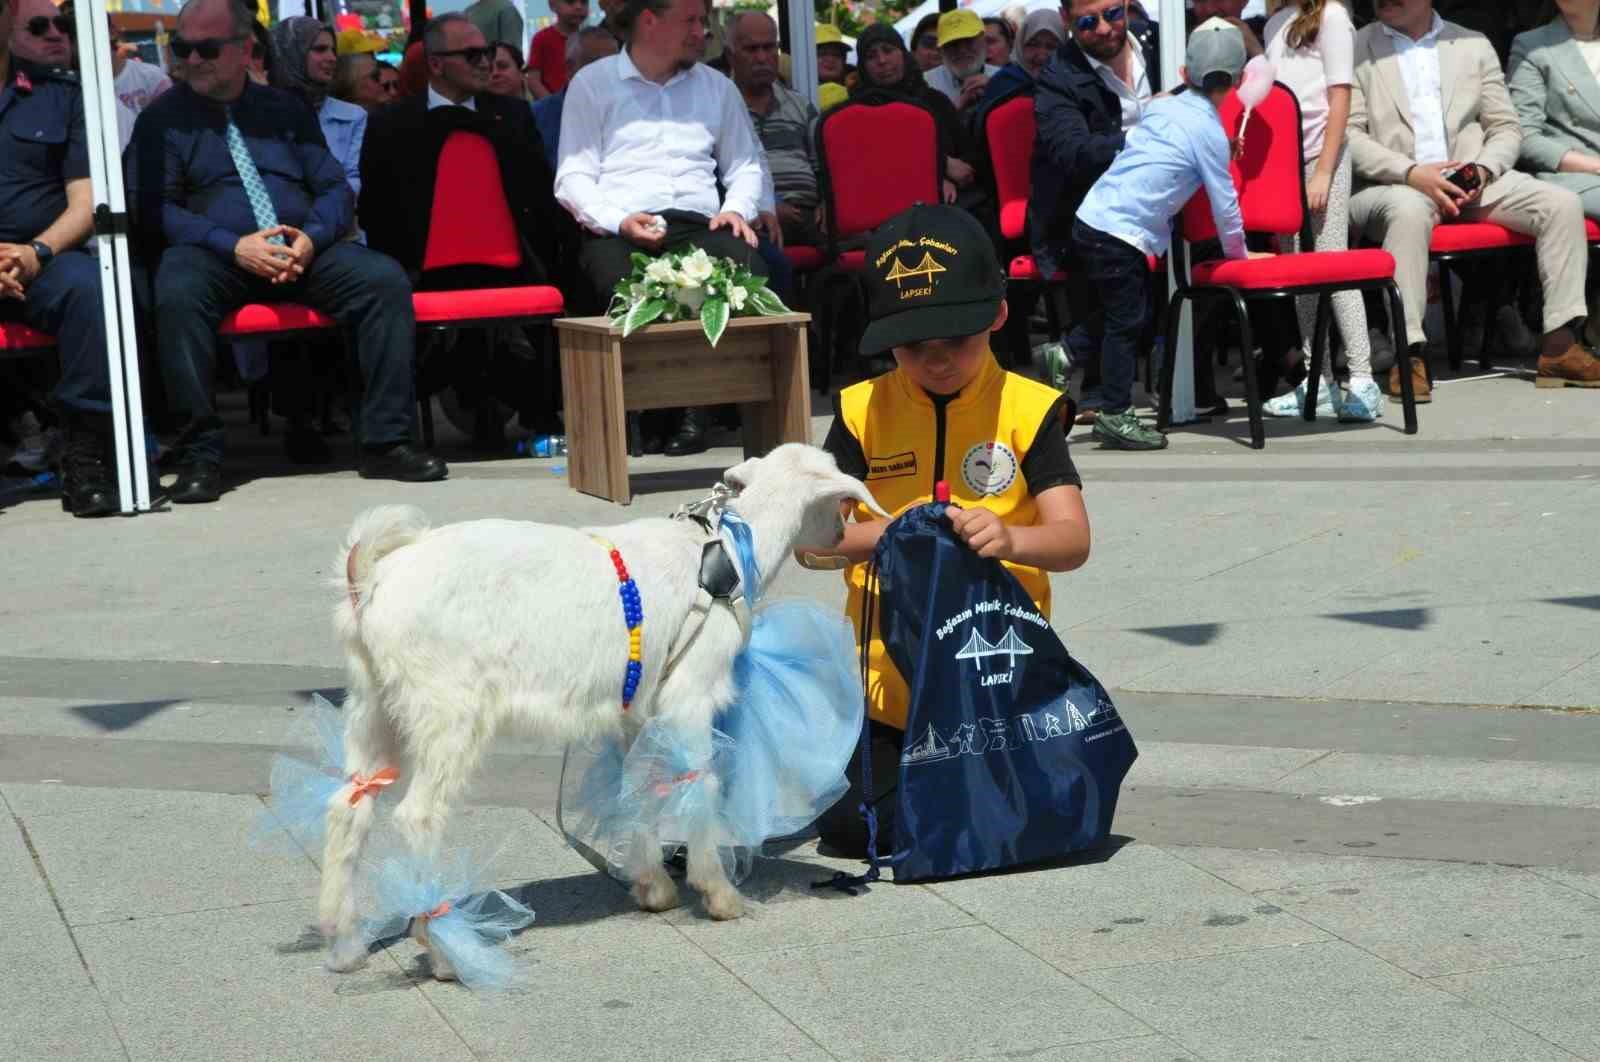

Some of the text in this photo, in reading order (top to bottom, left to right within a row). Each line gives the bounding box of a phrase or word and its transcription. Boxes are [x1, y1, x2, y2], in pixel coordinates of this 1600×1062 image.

[936, 599, 1049, 640] Boğazın Minik Çobanları
